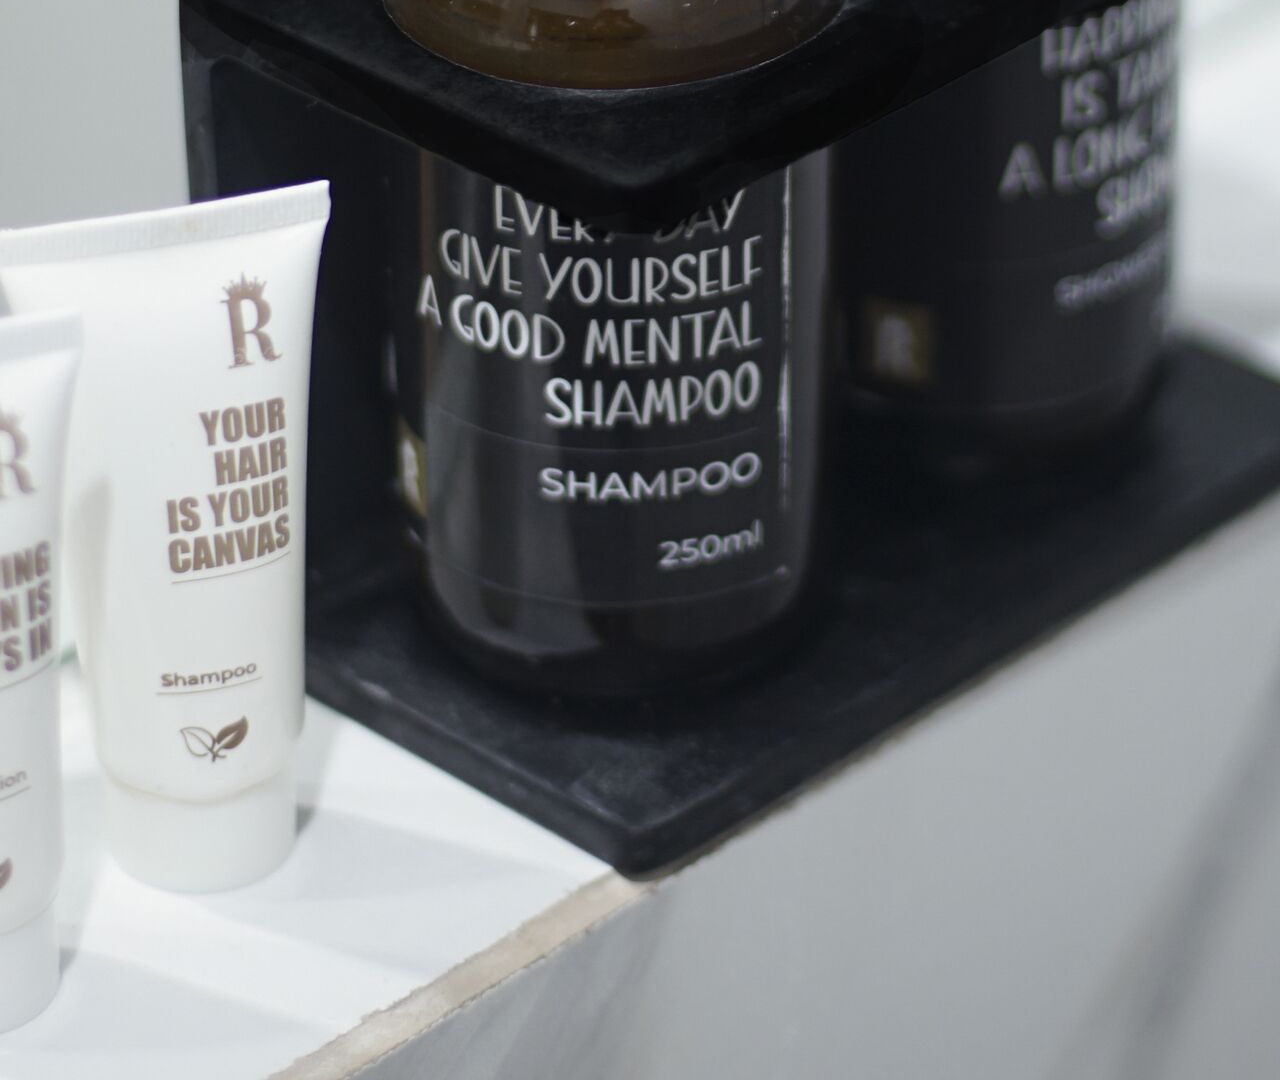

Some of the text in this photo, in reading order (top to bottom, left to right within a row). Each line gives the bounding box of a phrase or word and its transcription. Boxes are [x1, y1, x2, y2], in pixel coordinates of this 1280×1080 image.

[1060, 70, 1108, 126] IS
[998, 142, 1046, 200] A
[440, 228, 762, 304] GIVE YOURSELF
[419, 274, 763, 367] A GOOD MENTAL
[544, 360, 761, 428] SHAMPOO
[198, 396, 287, 446] YOUR
[213, 436, 288, 486] HAIR
[539, 451, 762, 501] SHAMPOO
[166, 475, 289, 534] IS YOUR
[167, 513, 292, 575] CANVAS
[657, 519, 764, 570] 250ml
[26, 580, 53, 624] IS
[28, 617, 54, 663] IN
[160, 662, 258, 689] Shampoo
